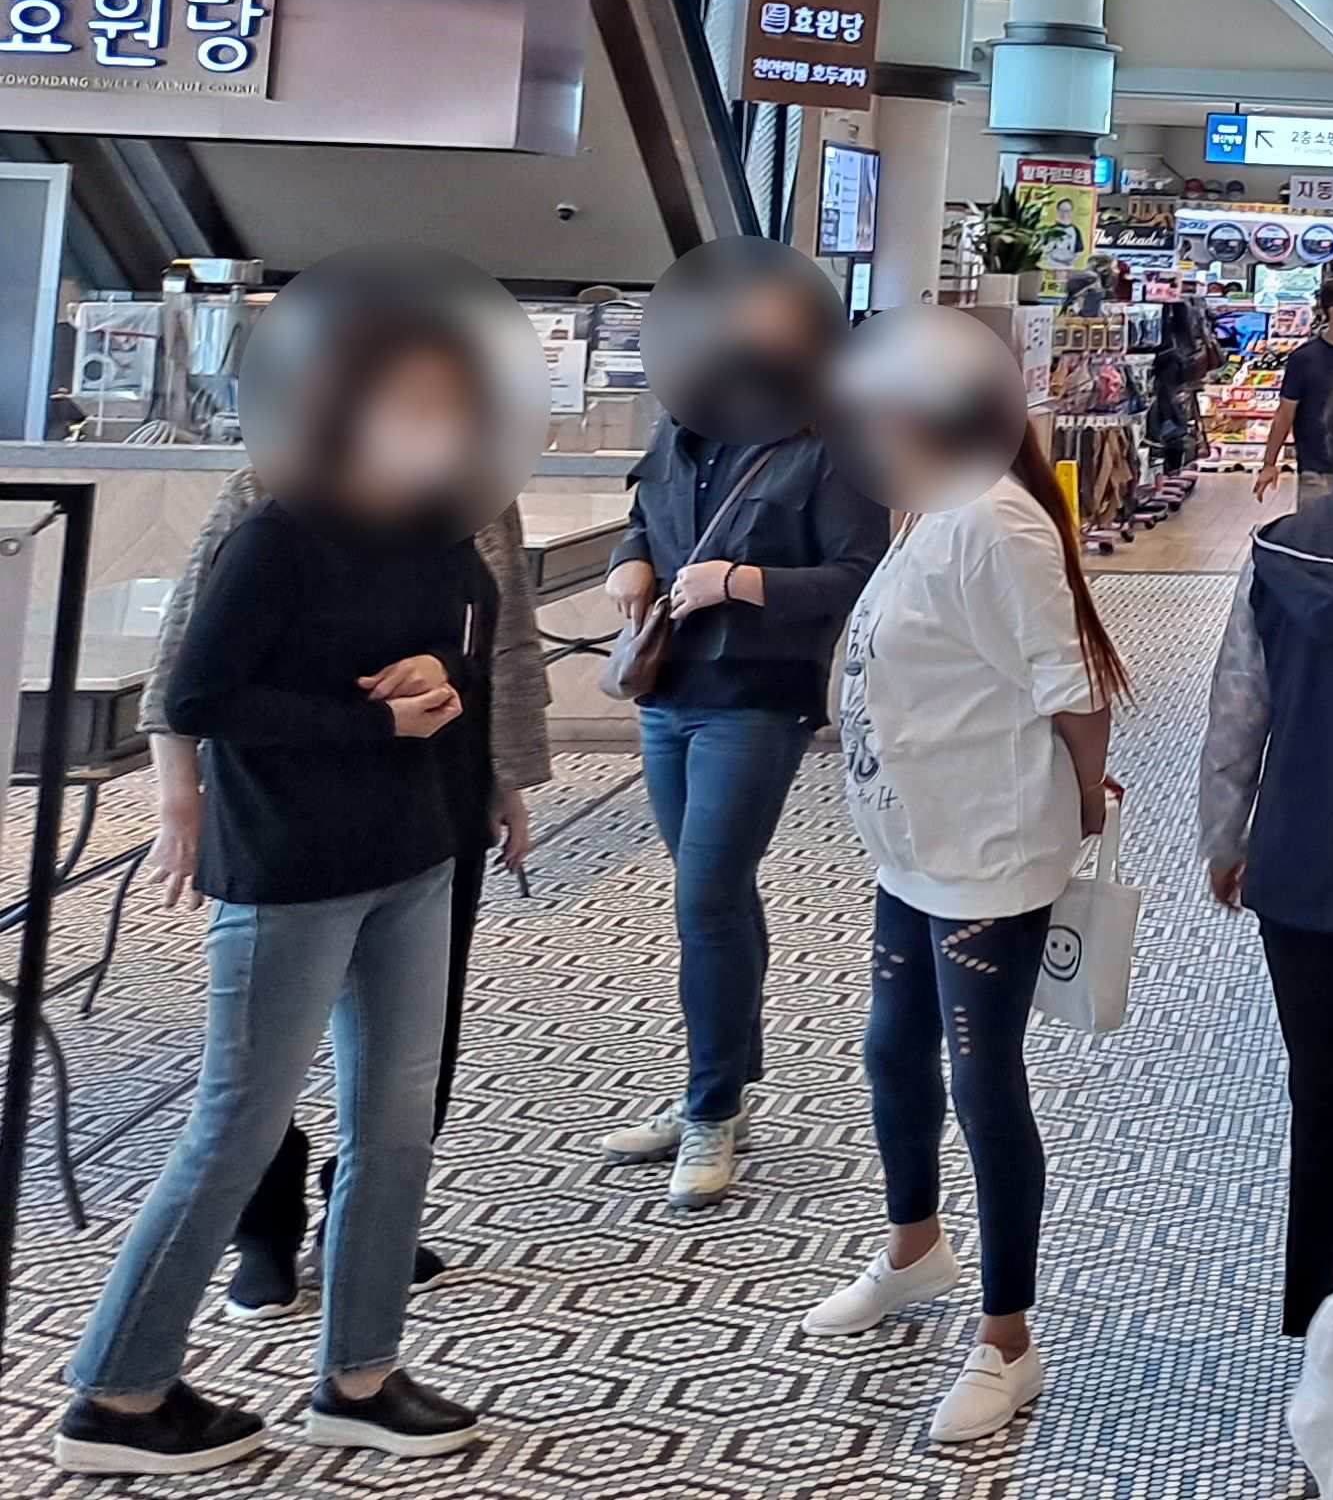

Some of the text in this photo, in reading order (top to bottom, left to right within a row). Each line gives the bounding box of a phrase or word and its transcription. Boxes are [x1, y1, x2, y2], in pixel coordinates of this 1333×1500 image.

[790, 6, 865, 42] 효원당
[753, 57, 867, 87] 천안명물 호두과자
[1291, 131, 1311, 145] 2층
